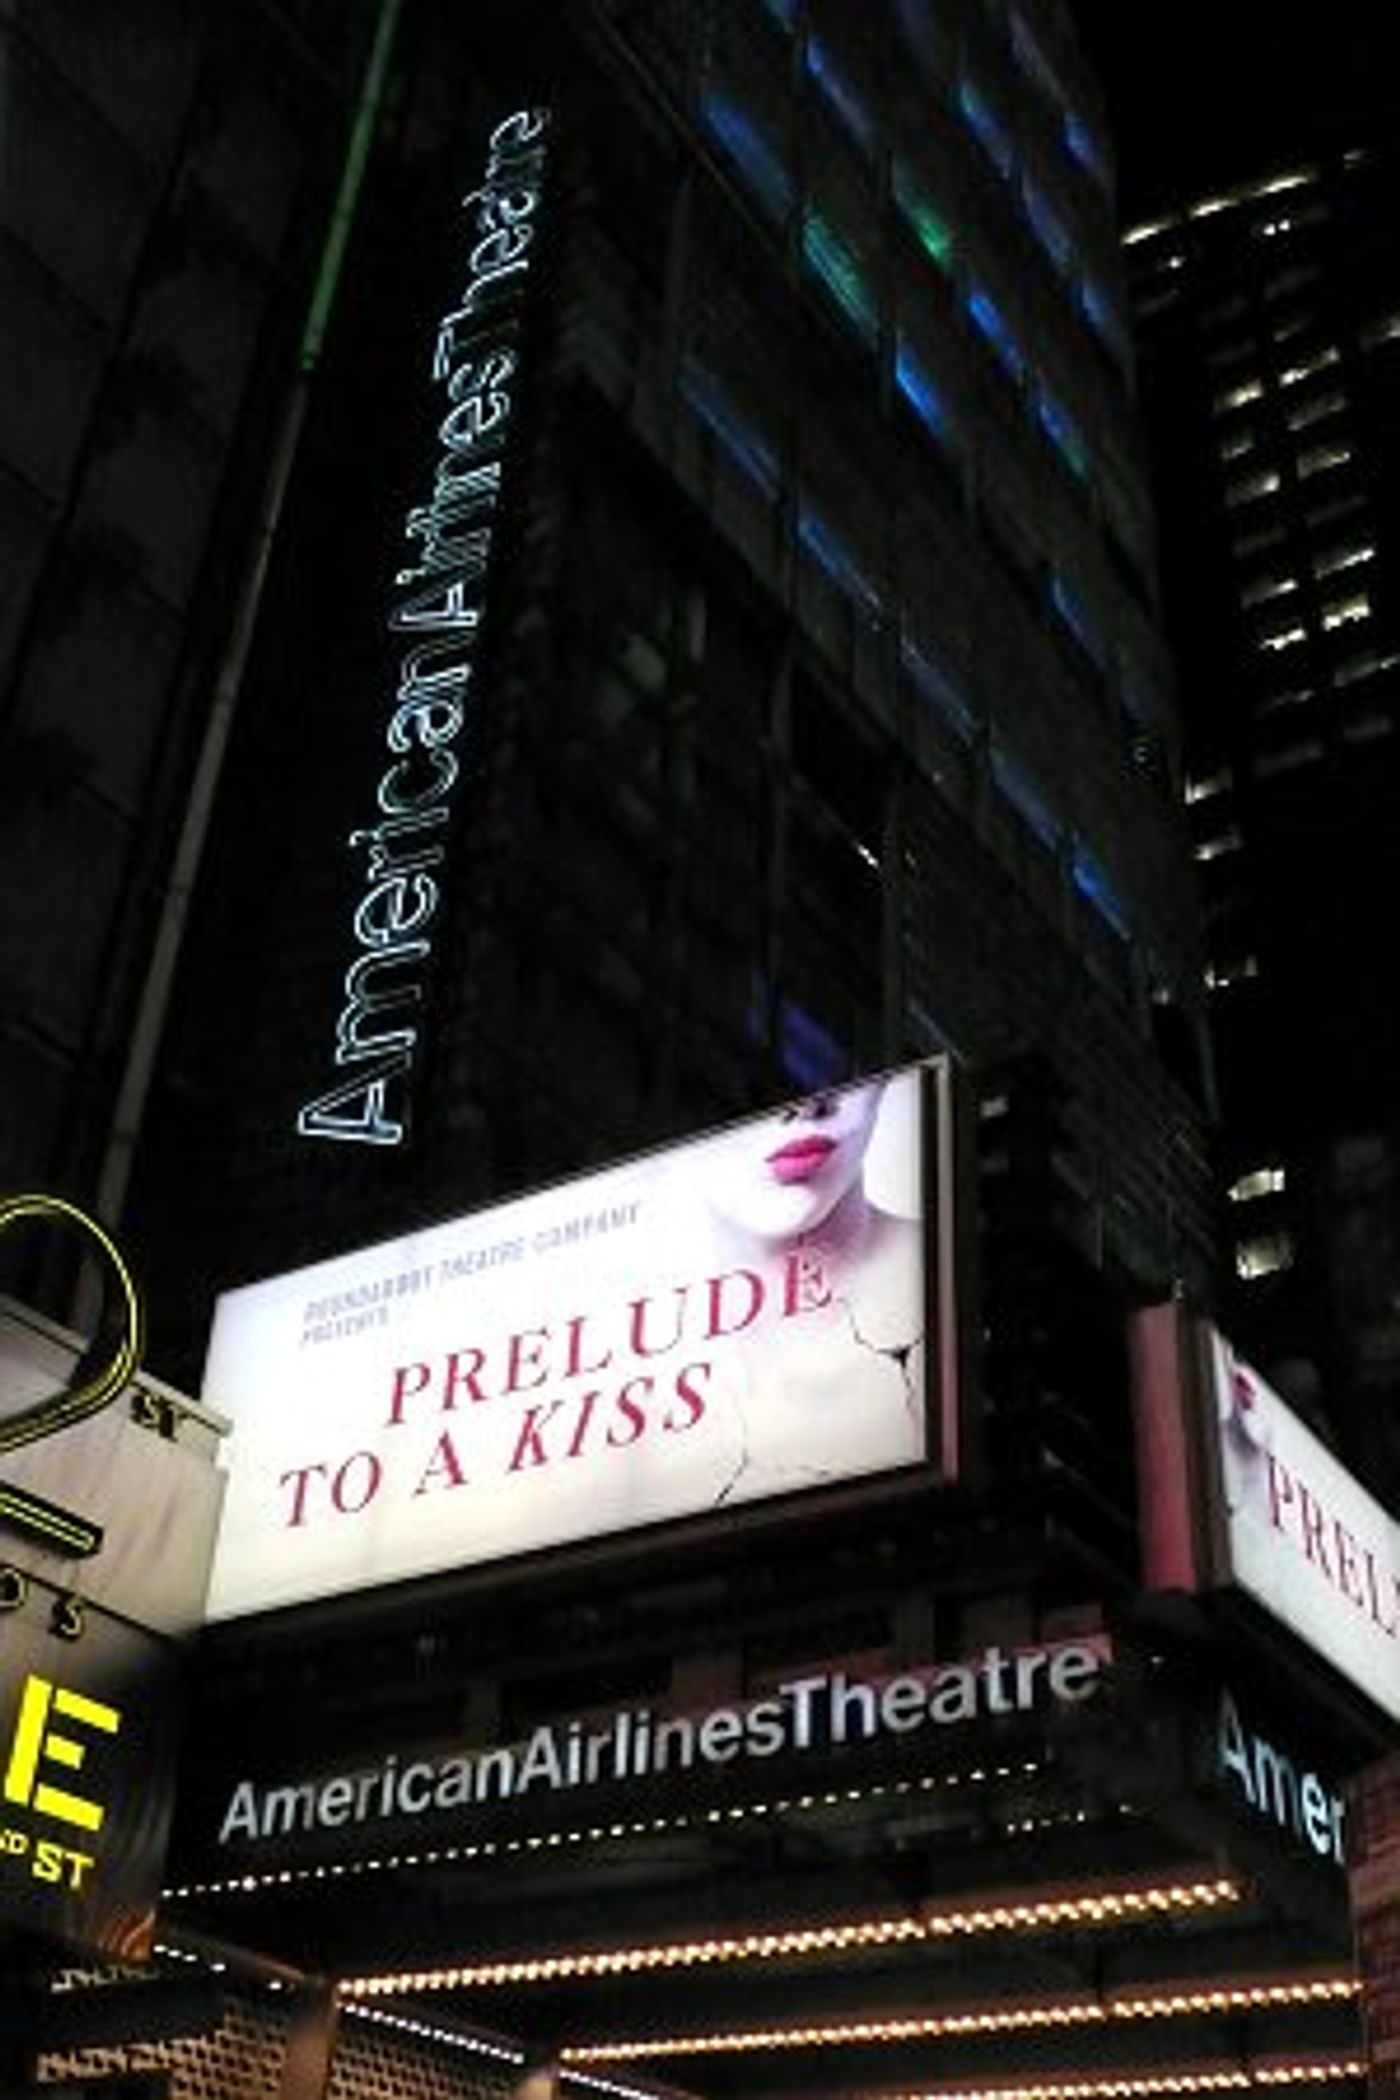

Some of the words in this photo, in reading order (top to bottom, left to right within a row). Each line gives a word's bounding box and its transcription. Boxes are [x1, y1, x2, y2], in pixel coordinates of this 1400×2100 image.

[386, 1253, 834, 1427] PRELUDE
[278, 1450, 383, 1528] TO
[414, 1430, 467, 1496] A
[505, 1361, 714, 1475] KISS
[32, 1840, 95, 1890] ST
